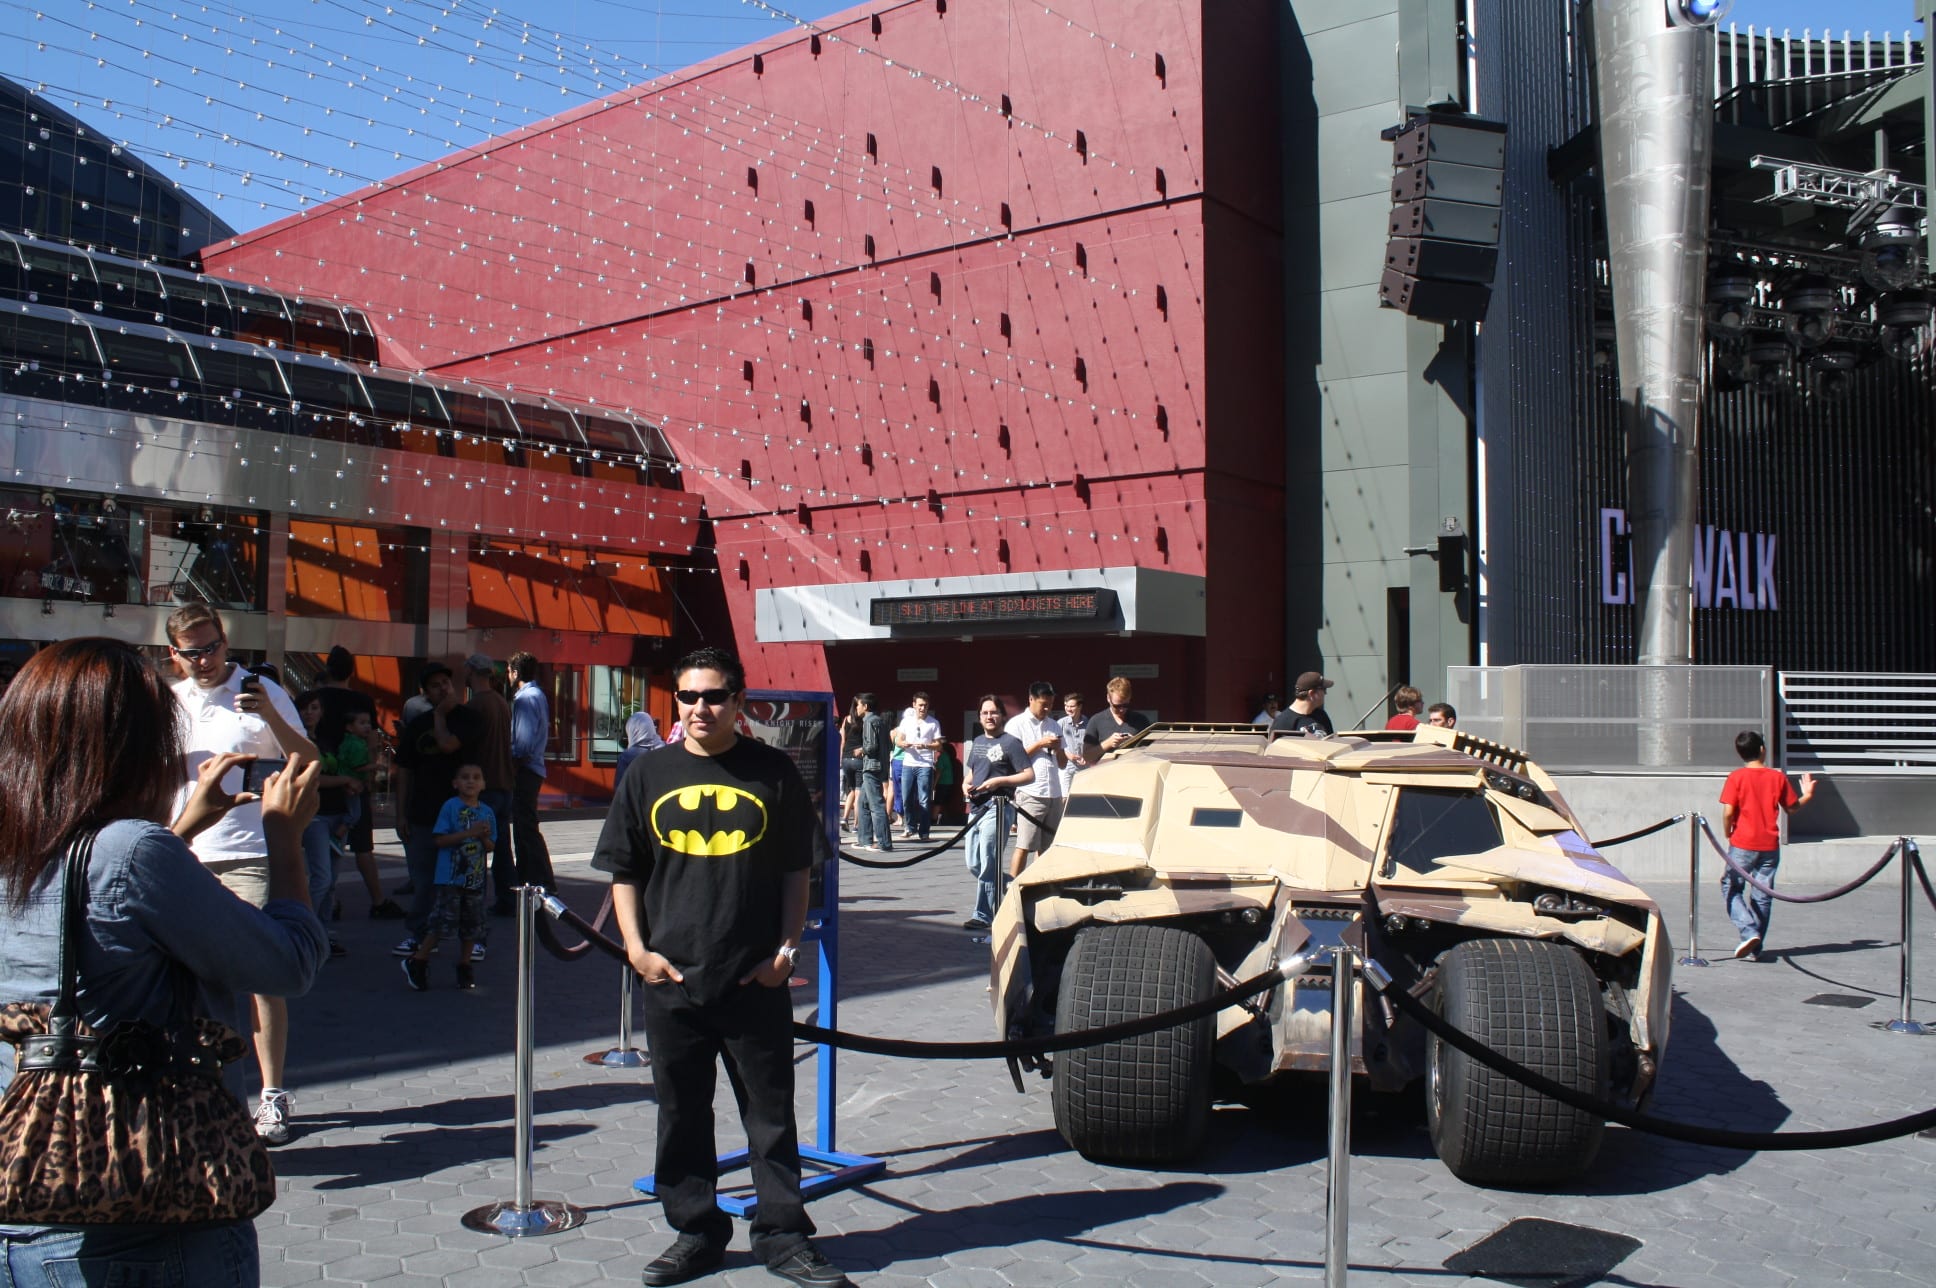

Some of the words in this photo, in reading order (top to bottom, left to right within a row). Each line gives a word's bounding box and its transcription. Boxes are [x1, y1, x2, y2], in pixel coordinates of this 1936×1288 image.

[953, 599, 976, 614] LINE
[979, 598, 994, 613] AT
[1065, 595, 1096, 609] HERE
[764, 719, 795, 728] KNIGHT
